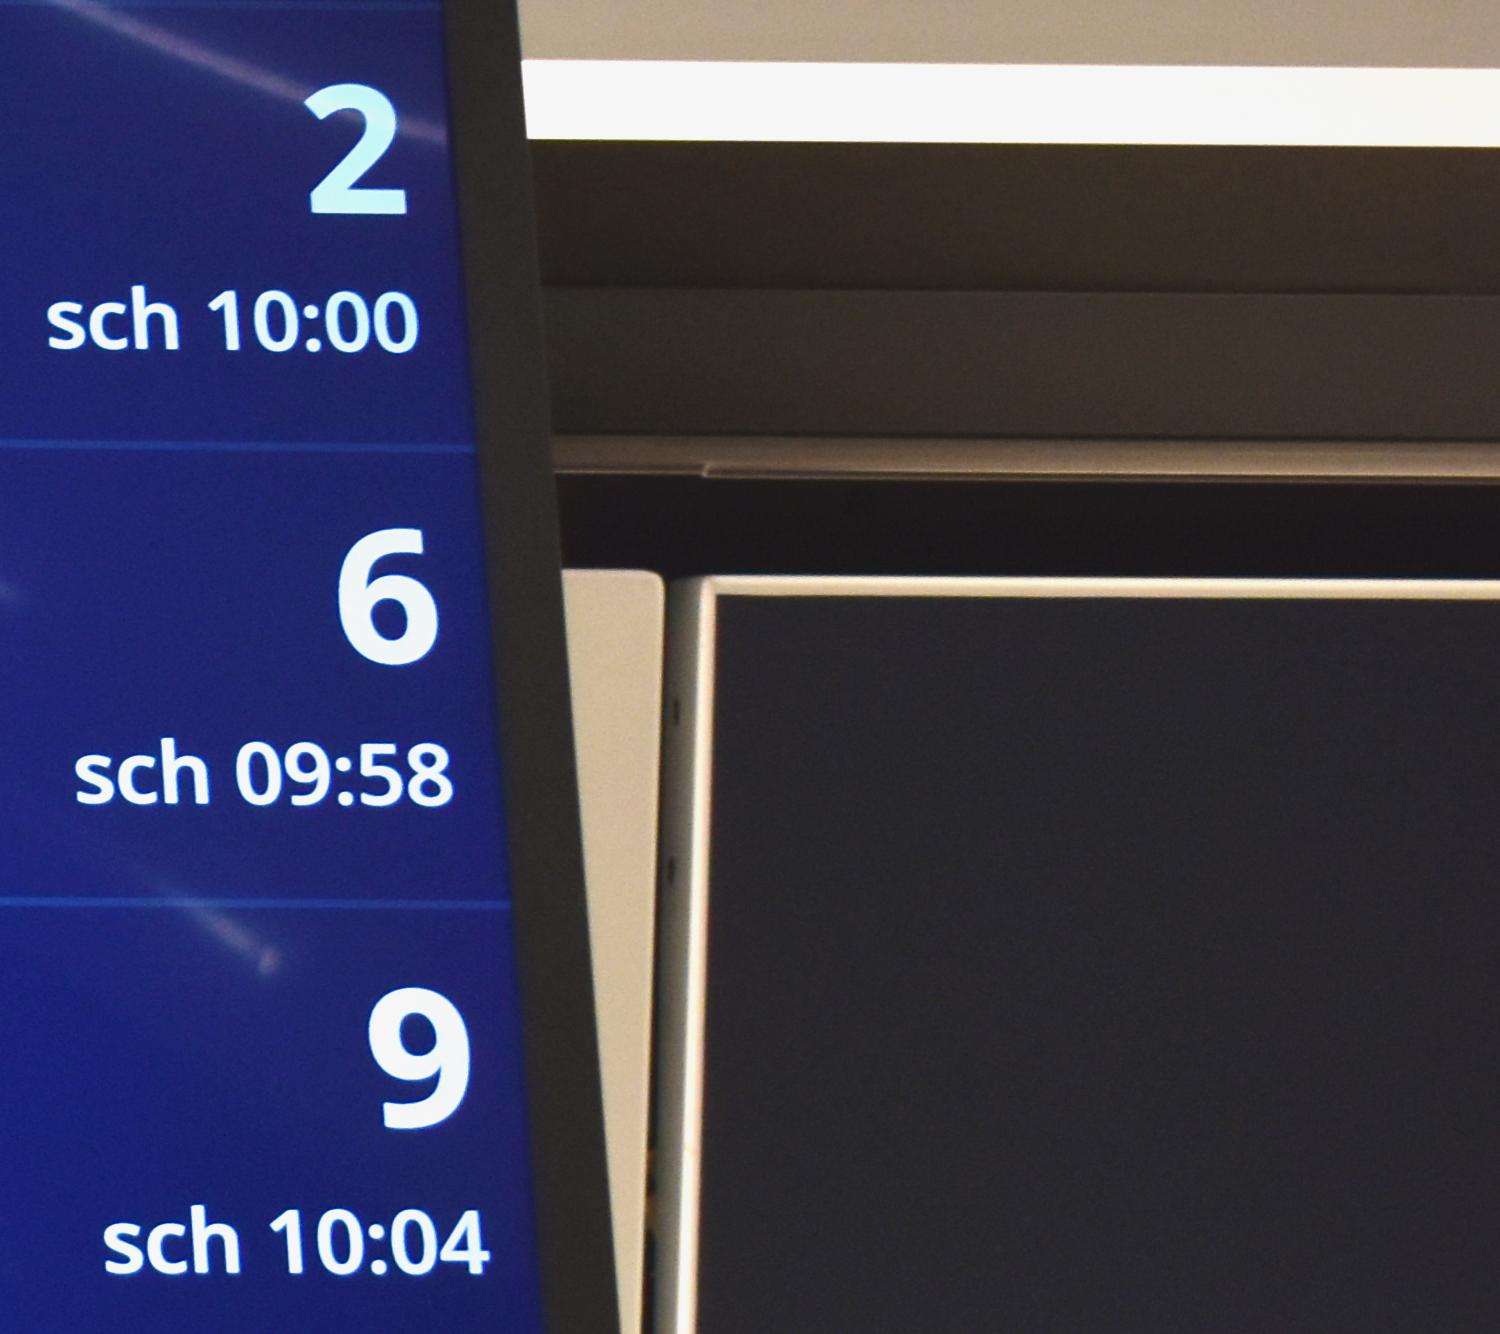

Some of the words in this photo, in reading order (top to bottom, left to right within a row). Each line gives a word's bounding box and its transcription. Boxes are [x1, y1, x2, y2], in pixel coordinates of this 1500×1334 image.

[303, 82, 408, 216] 2
[46, 284, 180, 352] sch
[207, 288, 419, 355] 10:00
[337, 527, 440, 667] 6
[73, 736, 211, 806] sch
[234, 740, 455, 809] 09:58
[367, 986, 472, 1131] 9
[102, 1203, 242, 1276] sch
[268, 1207, 492, 1277] 10:04
